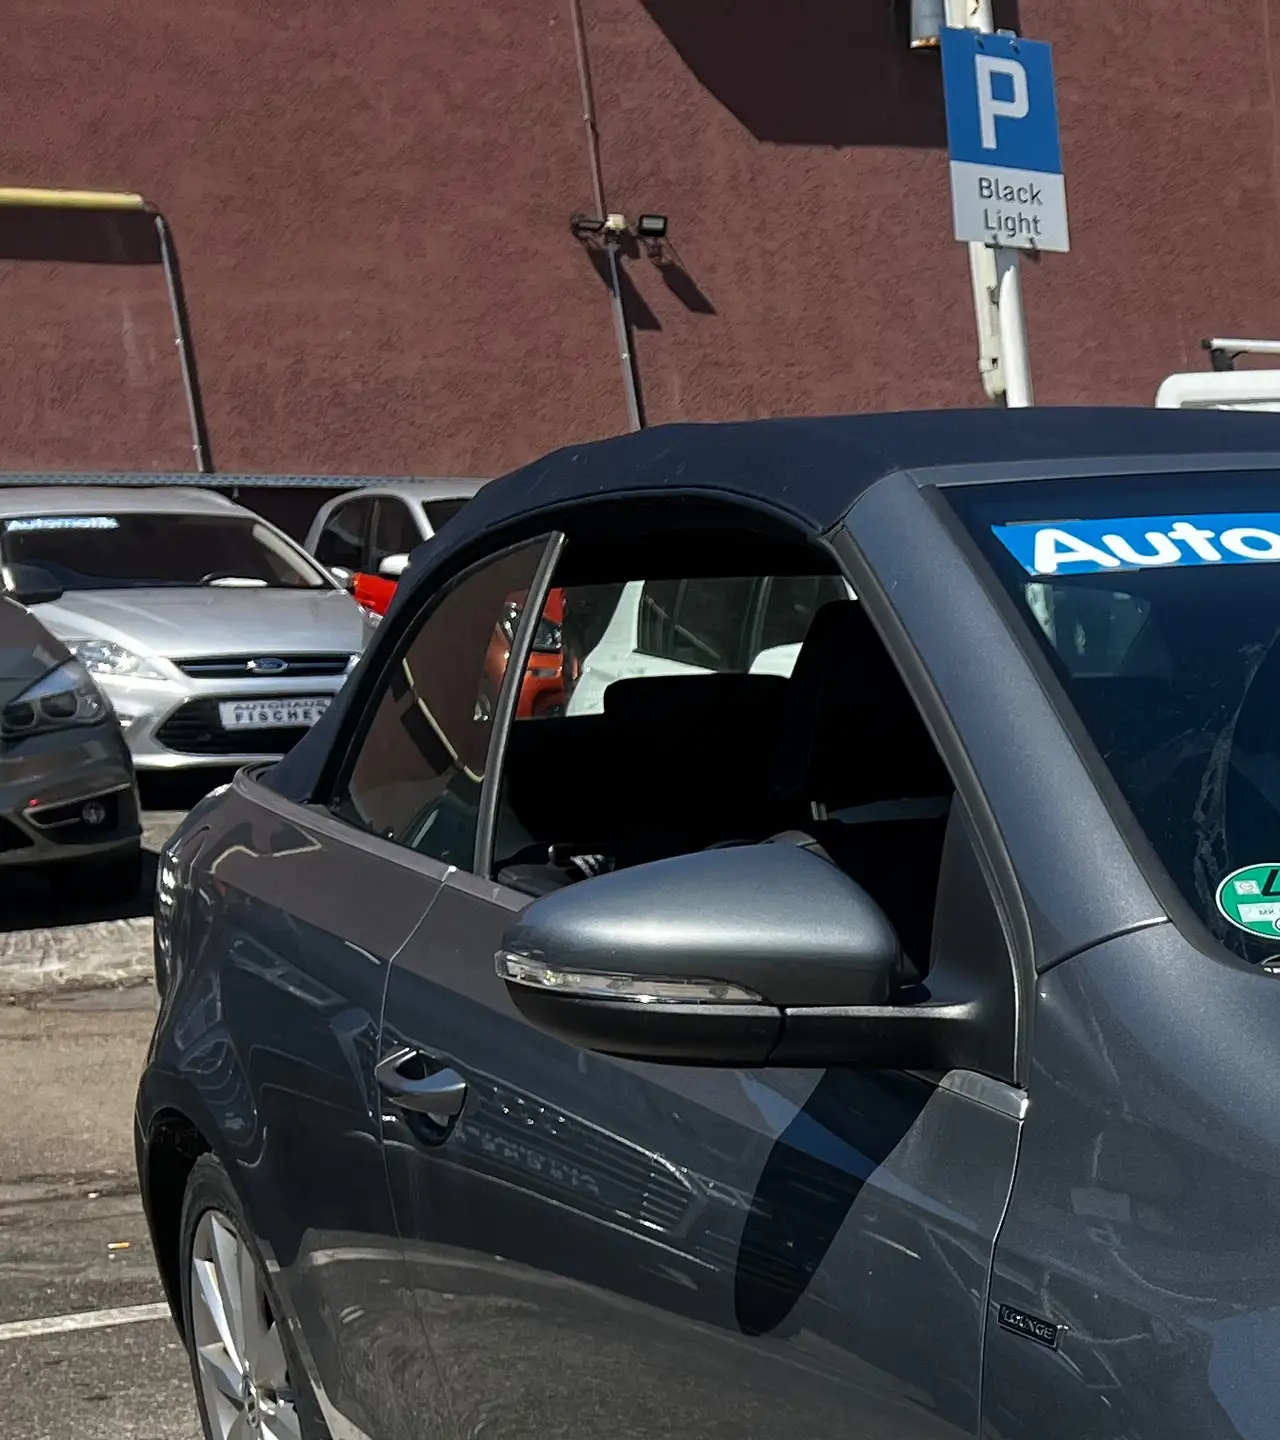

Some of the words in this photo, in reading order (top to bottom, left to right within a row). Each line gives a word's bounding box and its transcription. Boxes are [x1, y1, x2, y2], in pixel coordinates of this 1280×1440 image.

[974, 53, 1030, 150] P
[978, 177, 1044, 206] Black
[984, 208, 1042, 237] Light
